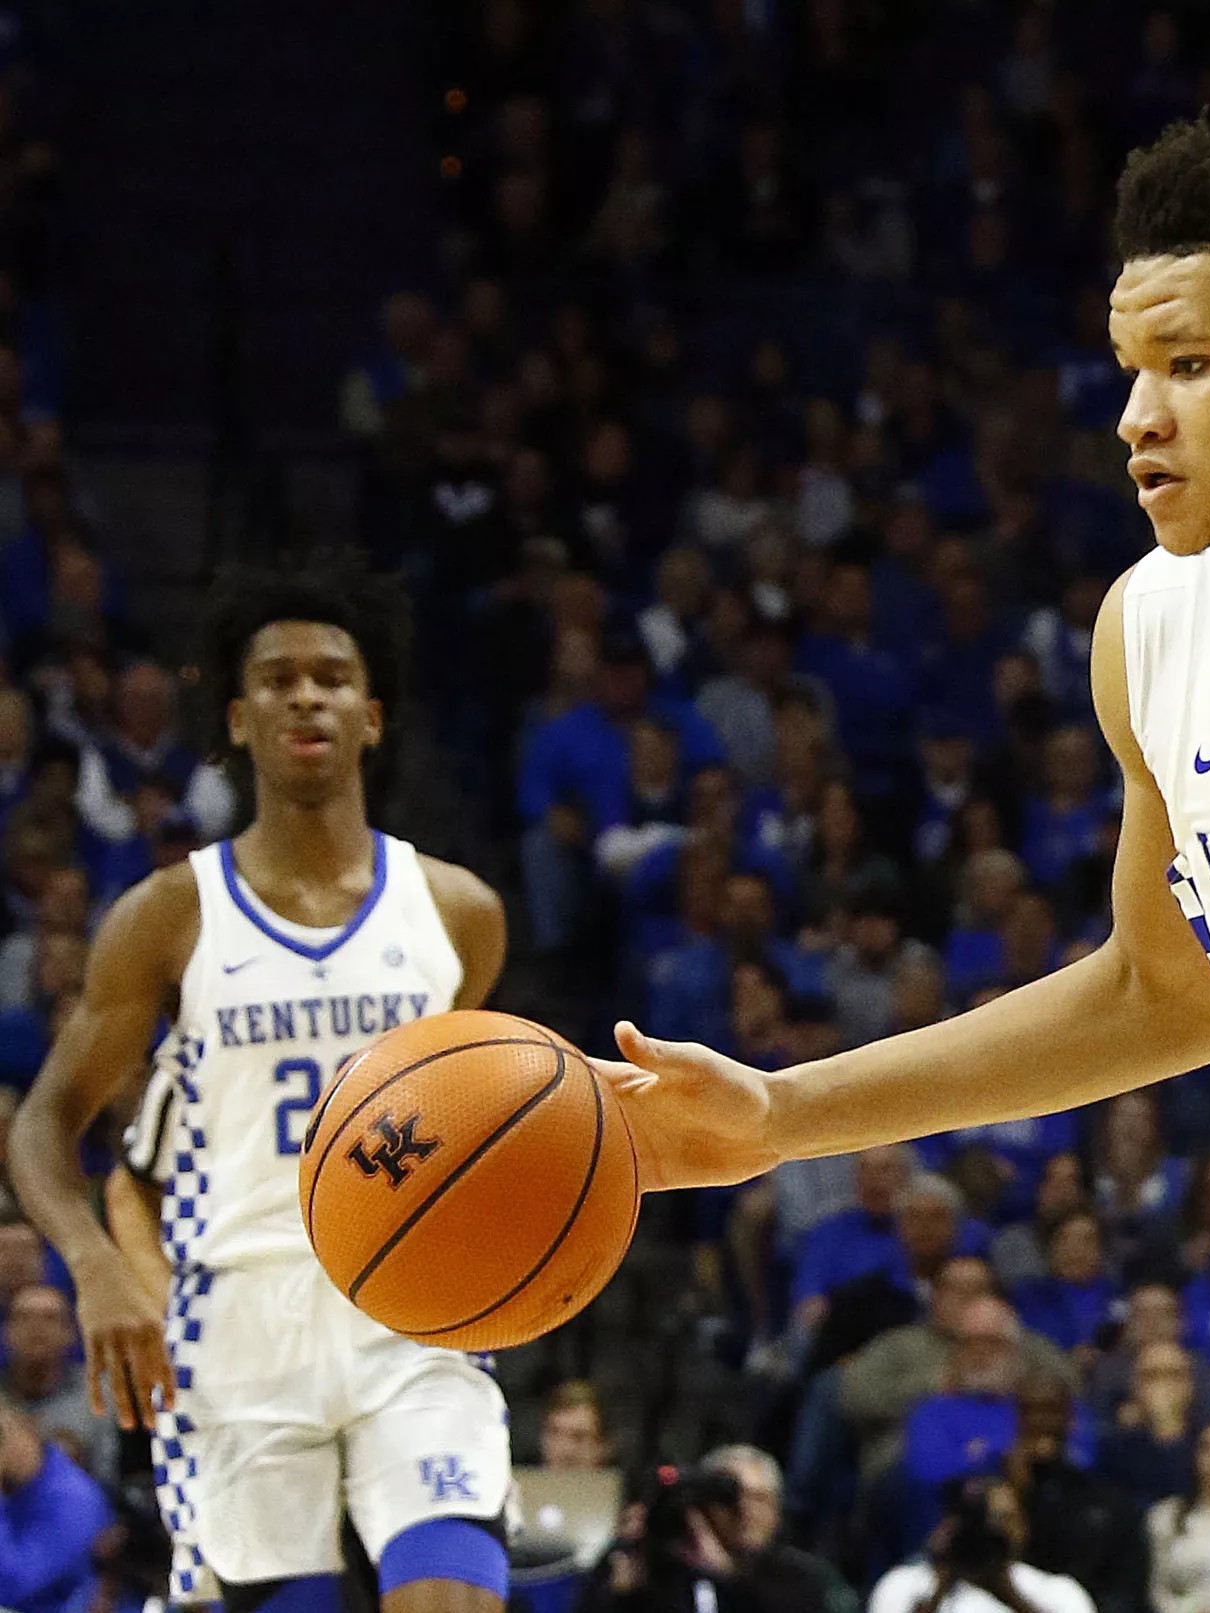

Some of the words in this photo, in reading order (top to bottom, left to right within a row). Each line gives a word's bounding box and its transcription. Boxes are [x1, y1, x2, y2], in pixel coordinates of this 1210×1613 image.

[216, 992, 429, 1048] KENTUCKY
[275, 1054, 354, 1154] 2
[346, 1111, 443, 1189] UK
[415, 1452, 480, 1503] UK
